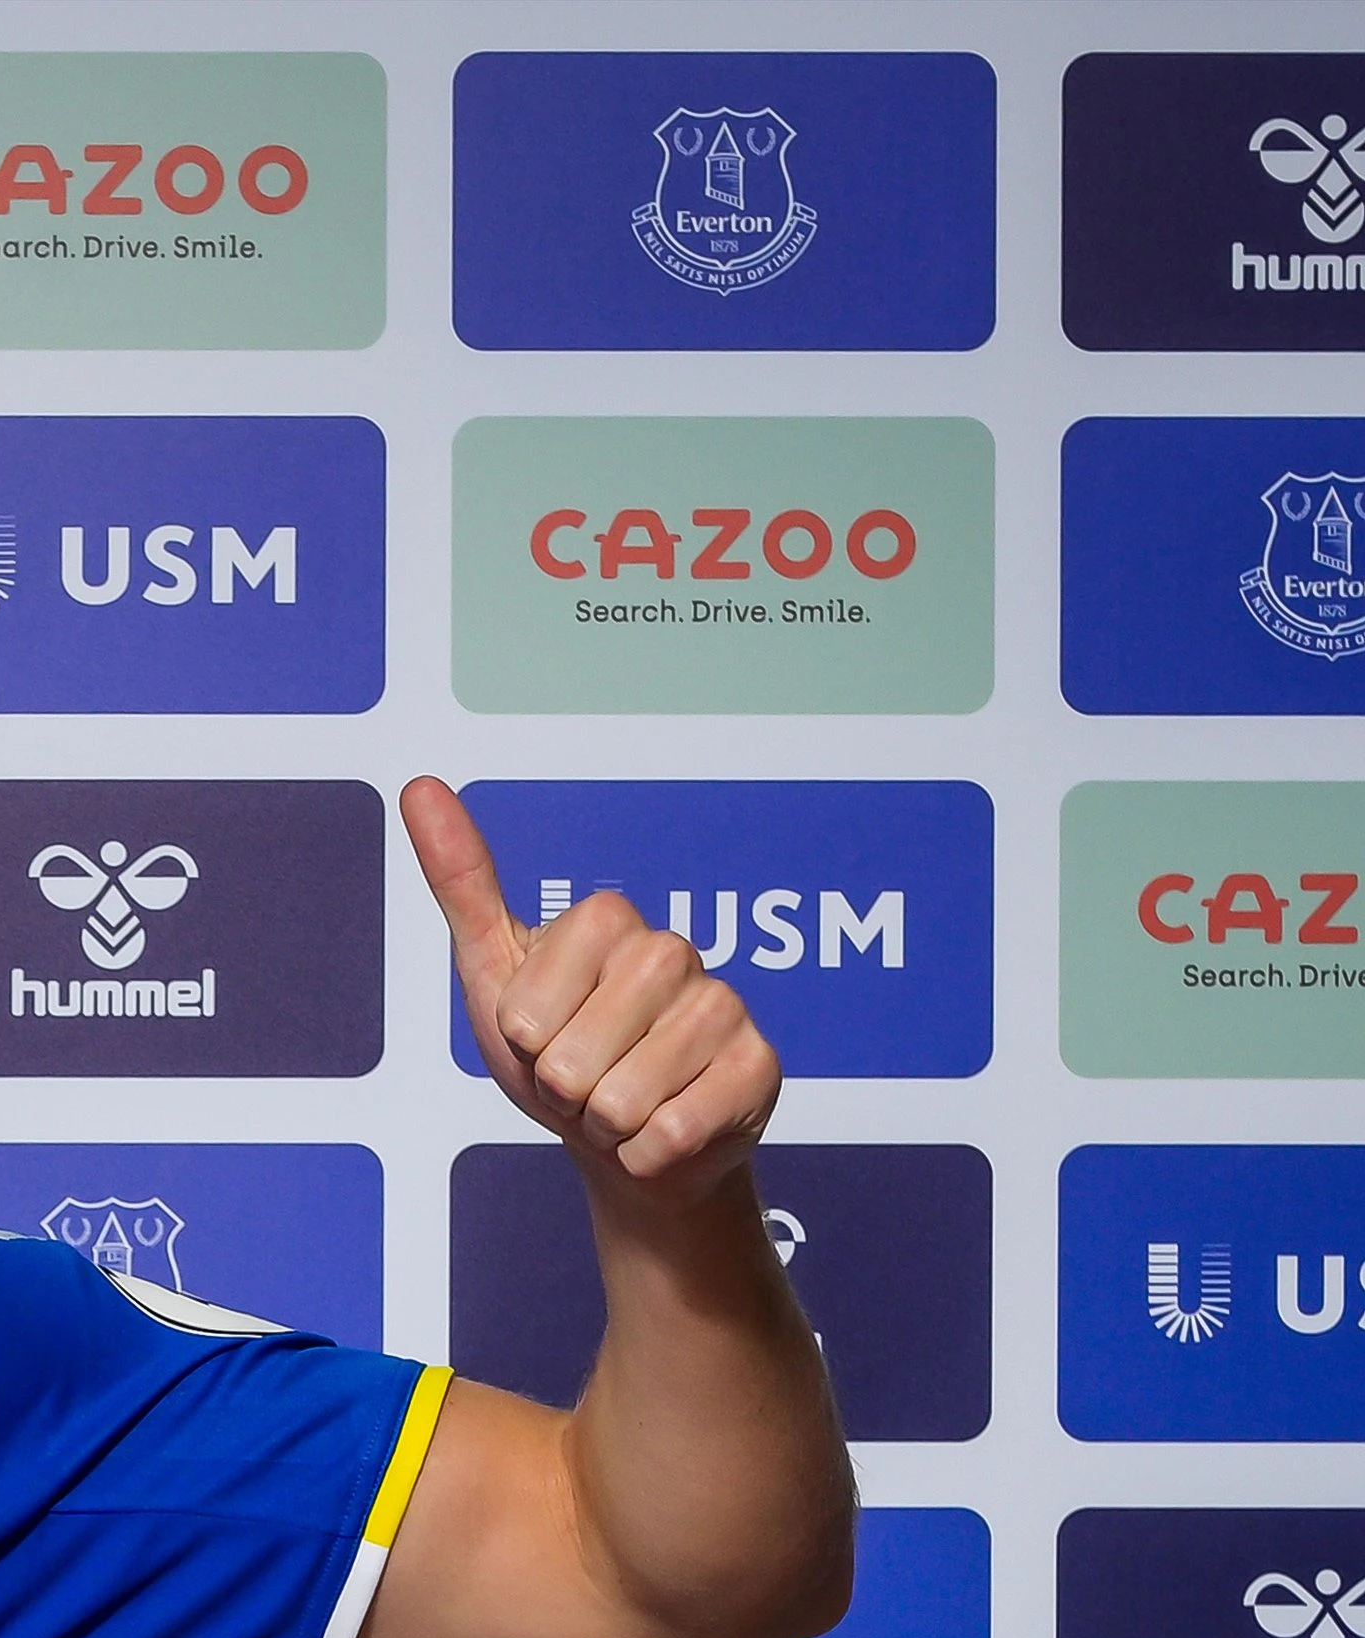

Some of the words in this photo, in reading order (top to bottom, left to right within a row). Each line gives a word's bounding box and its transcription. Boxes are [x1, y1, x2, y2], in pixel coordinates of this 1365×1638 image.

[83, 234, 165, 258] Drive.
[172, 234, 262, 258] Smile.
[677, 210, 773, 233] Everton
[644, 230, 663, 257] NIL
[665, 254, 704, 281] SATIS
[709, 272, 742, 285] NISI
[747, 230, 806, 280] OPTIMUM
[1232, 241, 1365, 290] hum
[62, 525, 296, 605] USM
[530, 509, 916, 580] CAZOO
[1284, 574, 1365, 597] Everto
[575, 599, 683, 623] Search.
[691, 599, 773, 623] Drive.
[780, 599, 870, 623] Smile.
[1251, 594, 1270, 621] NIL
[1272, 618, 1311, 645] SATIS
[1316, 636, 1349, 649] NISI
[669, 889, 903, 969] USM
[1137, 873, 1358, 944] CAZ
[12, 968, 215, 1017] hummel
[1182, 963, 1290, 987] Search.
[1298, 963, 1365, 987] Driv
